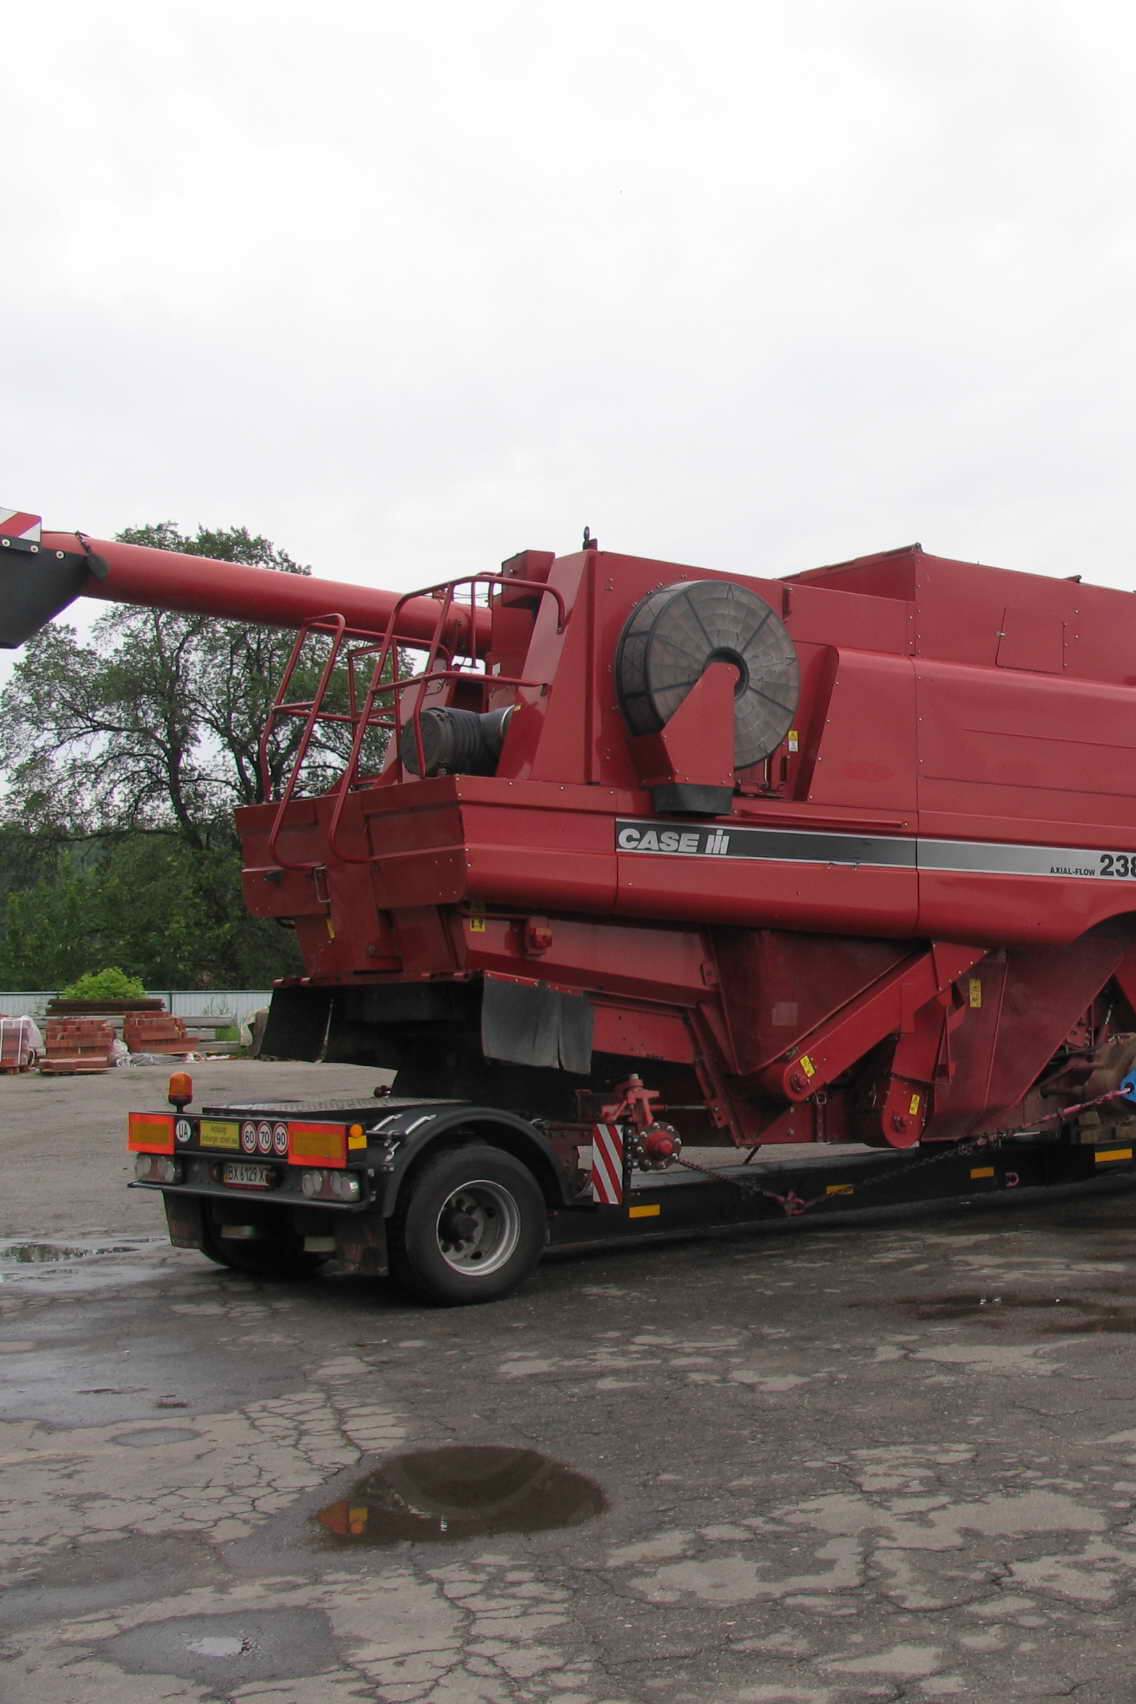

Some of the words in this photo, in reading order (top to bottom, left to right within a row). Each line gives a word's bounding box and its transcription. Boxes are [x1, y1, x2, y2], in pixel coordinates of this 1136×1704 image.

[618, 828, 700, 852] CASE
[1050, 867, 1095, 876] AXIAL-FLOW
[178, 1123, 189, 1138] UA
[261, 1131, 270, 1144] 70
